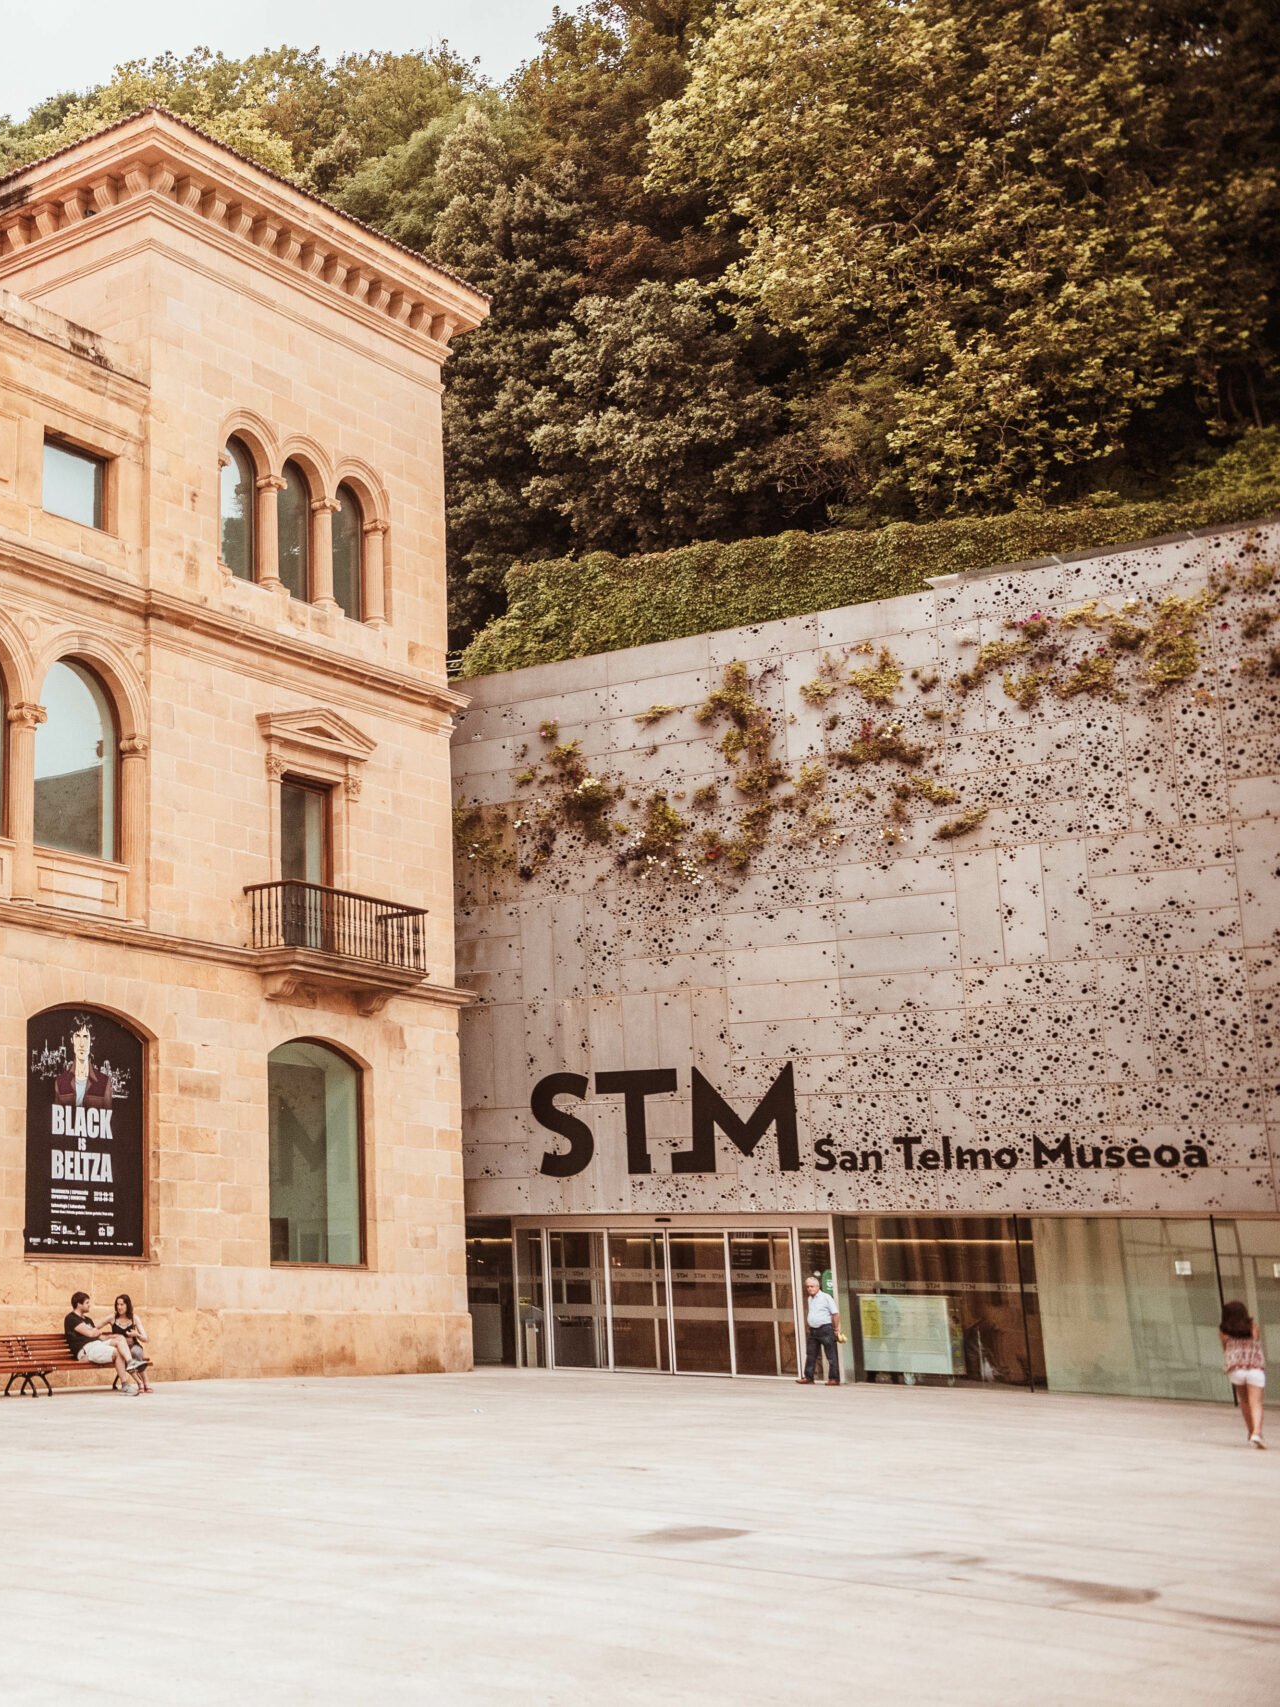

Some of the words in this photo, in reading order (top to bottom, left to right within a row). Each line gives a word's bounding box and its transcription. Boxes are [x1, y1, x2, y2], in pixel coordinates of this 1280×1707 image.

[51, 1103, 113, 1140] BLACK
[530, 1061, 800, 1177] STM
[813, 1138, 883, 1172] San
[893, 1136, 1018, 1171] Telmo
[1032, 1133, 1209, 1168] Museoa
[78, 1137, 87, 1151] IS
[51, 1149, 113, 1183] BELTZA
